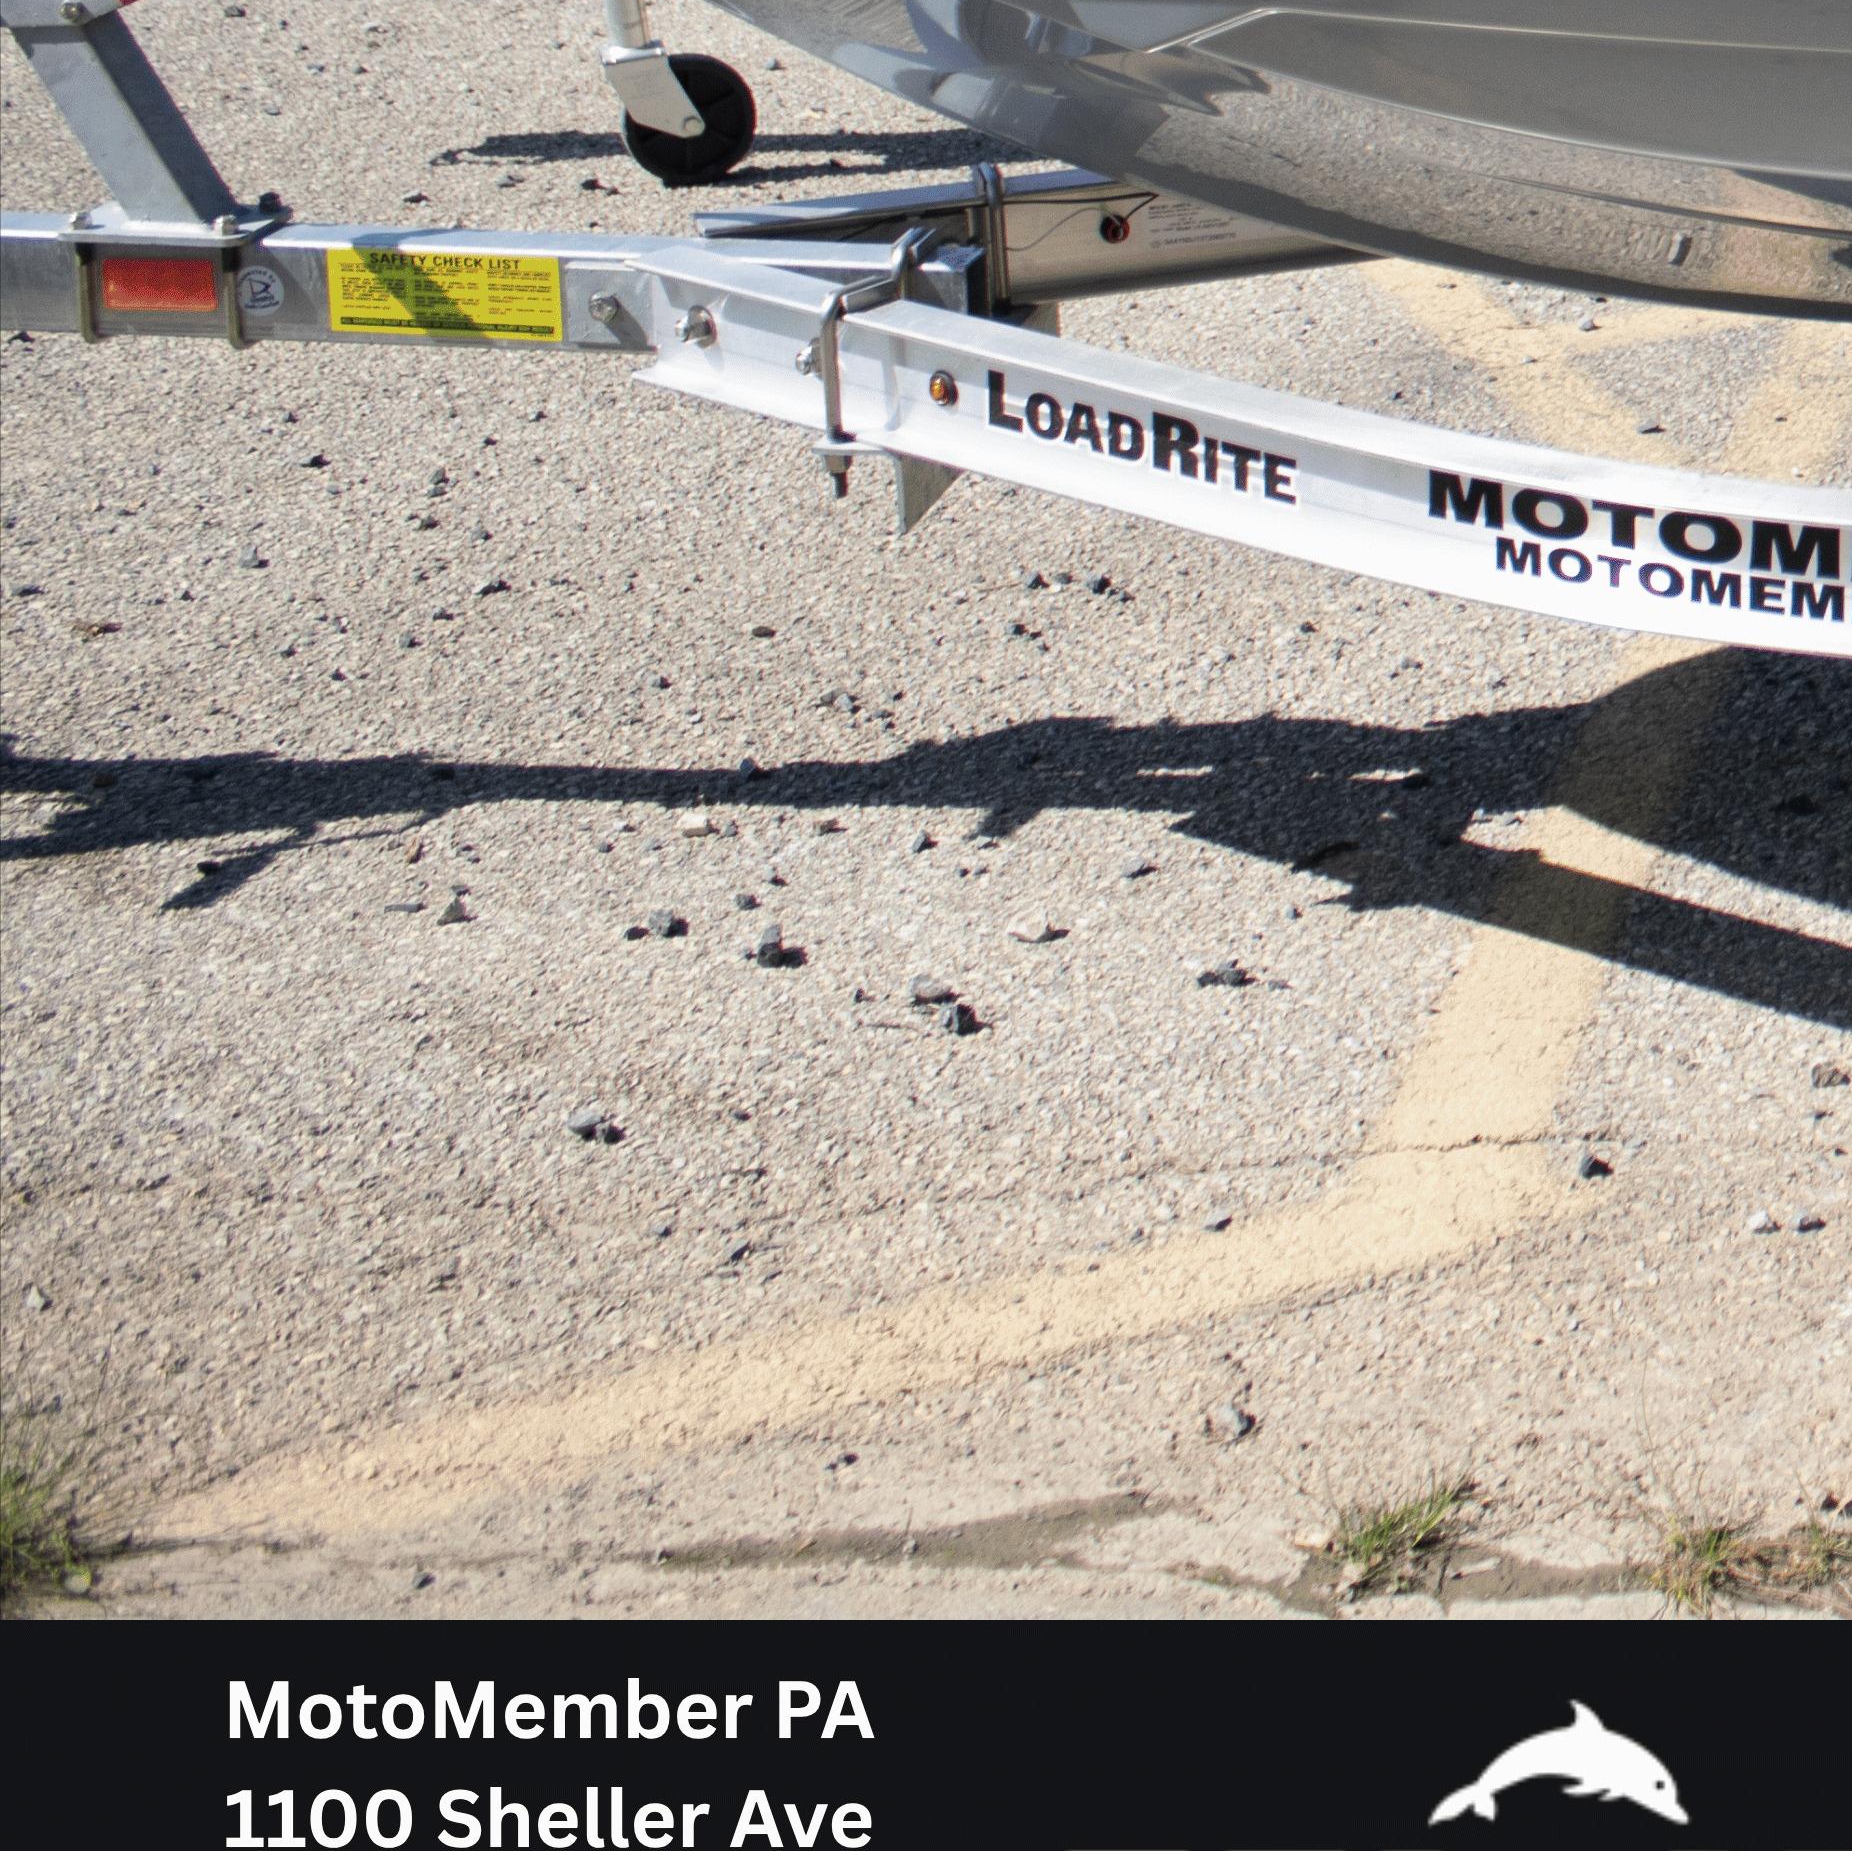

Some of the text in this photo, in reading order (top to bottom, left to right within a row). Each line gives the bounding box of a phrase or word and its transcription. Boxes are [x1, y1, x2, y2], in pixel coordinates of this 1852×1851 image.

[369, 252, 521, 270] SAFETY CHECK LIST
